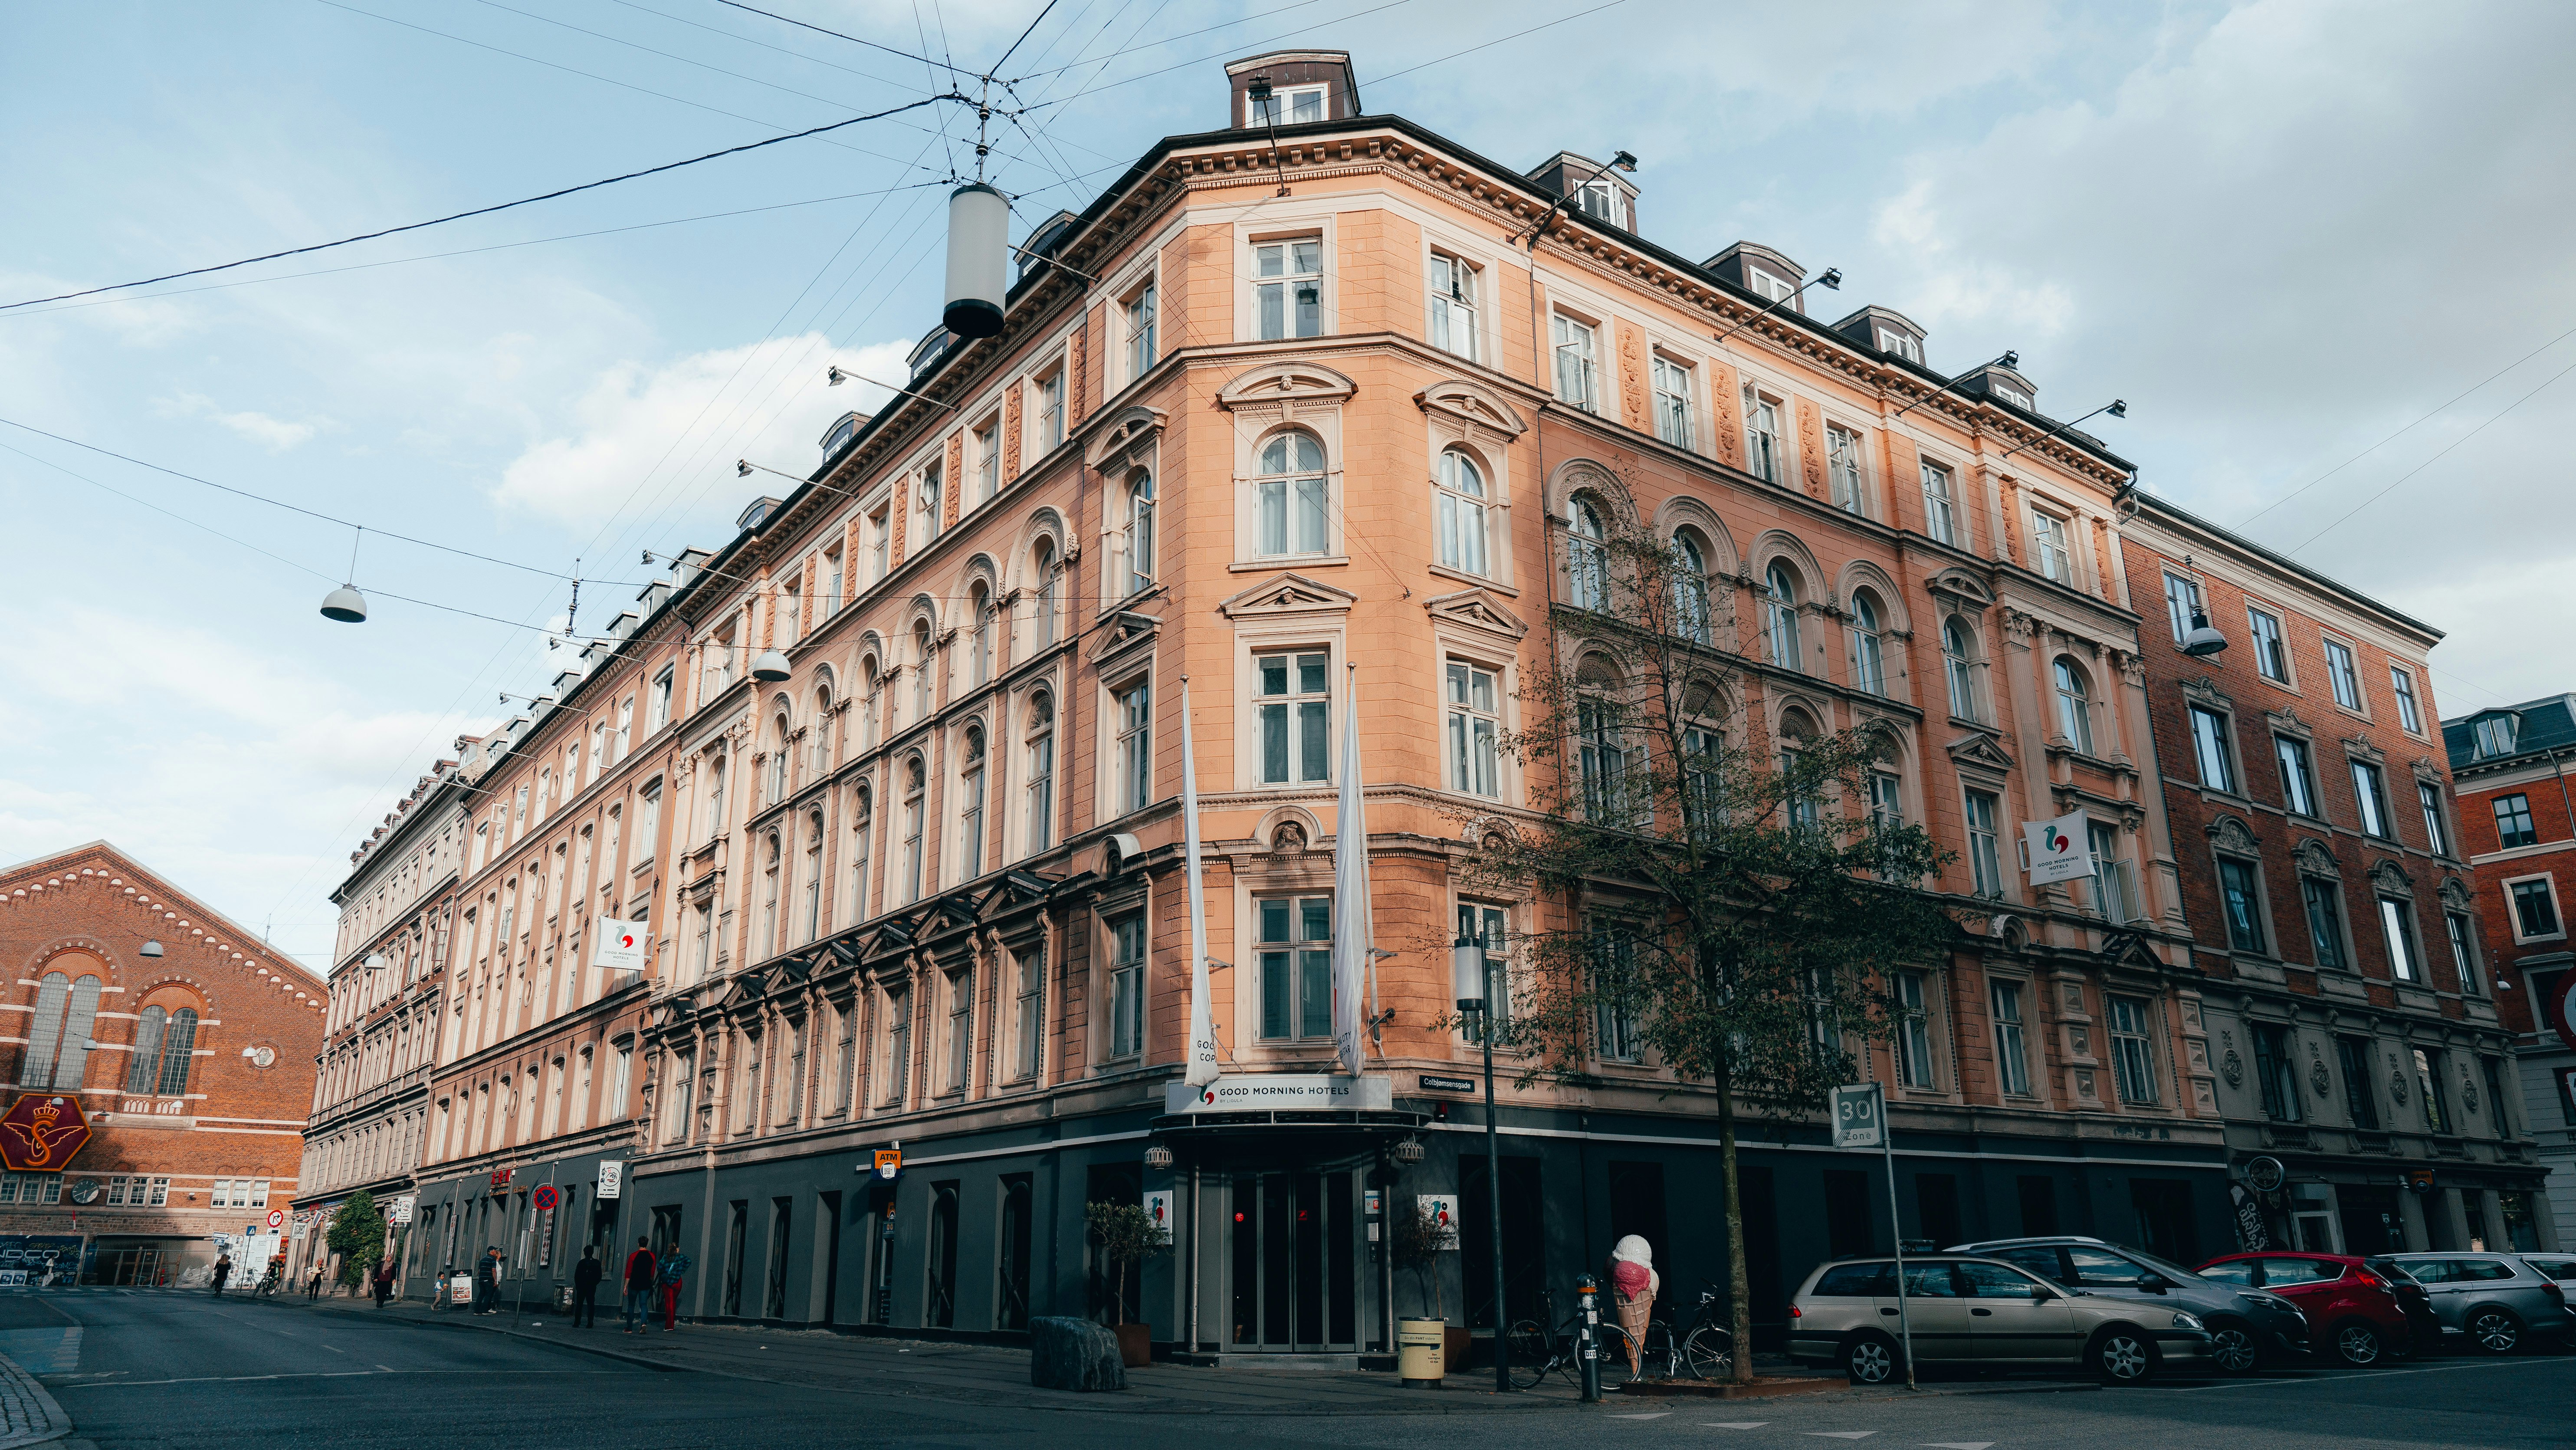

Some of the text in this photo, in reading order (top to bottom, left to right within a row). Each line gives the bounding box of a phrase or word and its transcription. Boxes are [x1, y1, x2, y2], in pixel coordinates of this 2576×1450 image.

[1342, 1031, 1351, 1042] CITY
[1841, 1100, 1871, 1121] 30
[1844, 1132, 1871, 1141] Zone
